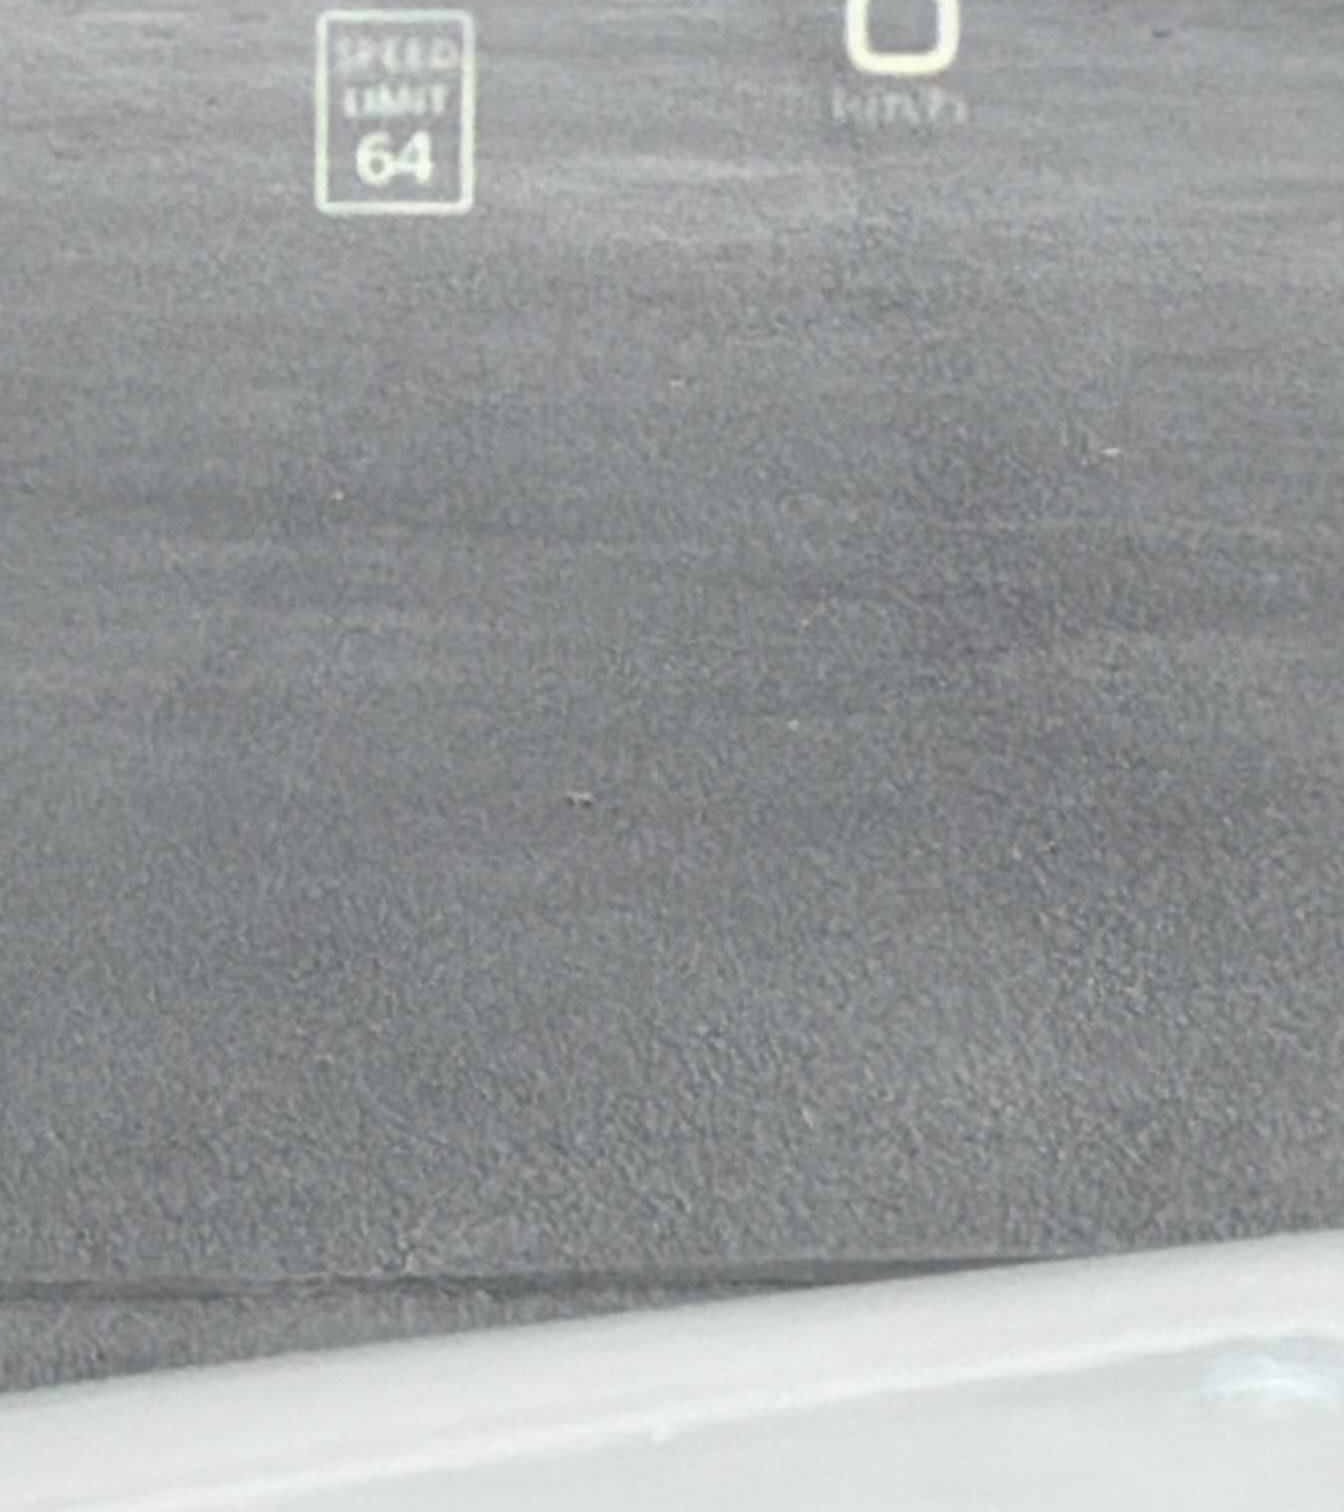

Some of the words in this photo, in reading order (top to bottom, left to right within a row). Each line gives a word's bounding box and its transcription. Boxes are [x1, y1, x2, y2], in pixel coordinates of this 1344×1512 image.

[334, 37, 459, 72] SPEED
[343, 85, 449, 118] LIMIT
[356, 131, 434, 185] 64
